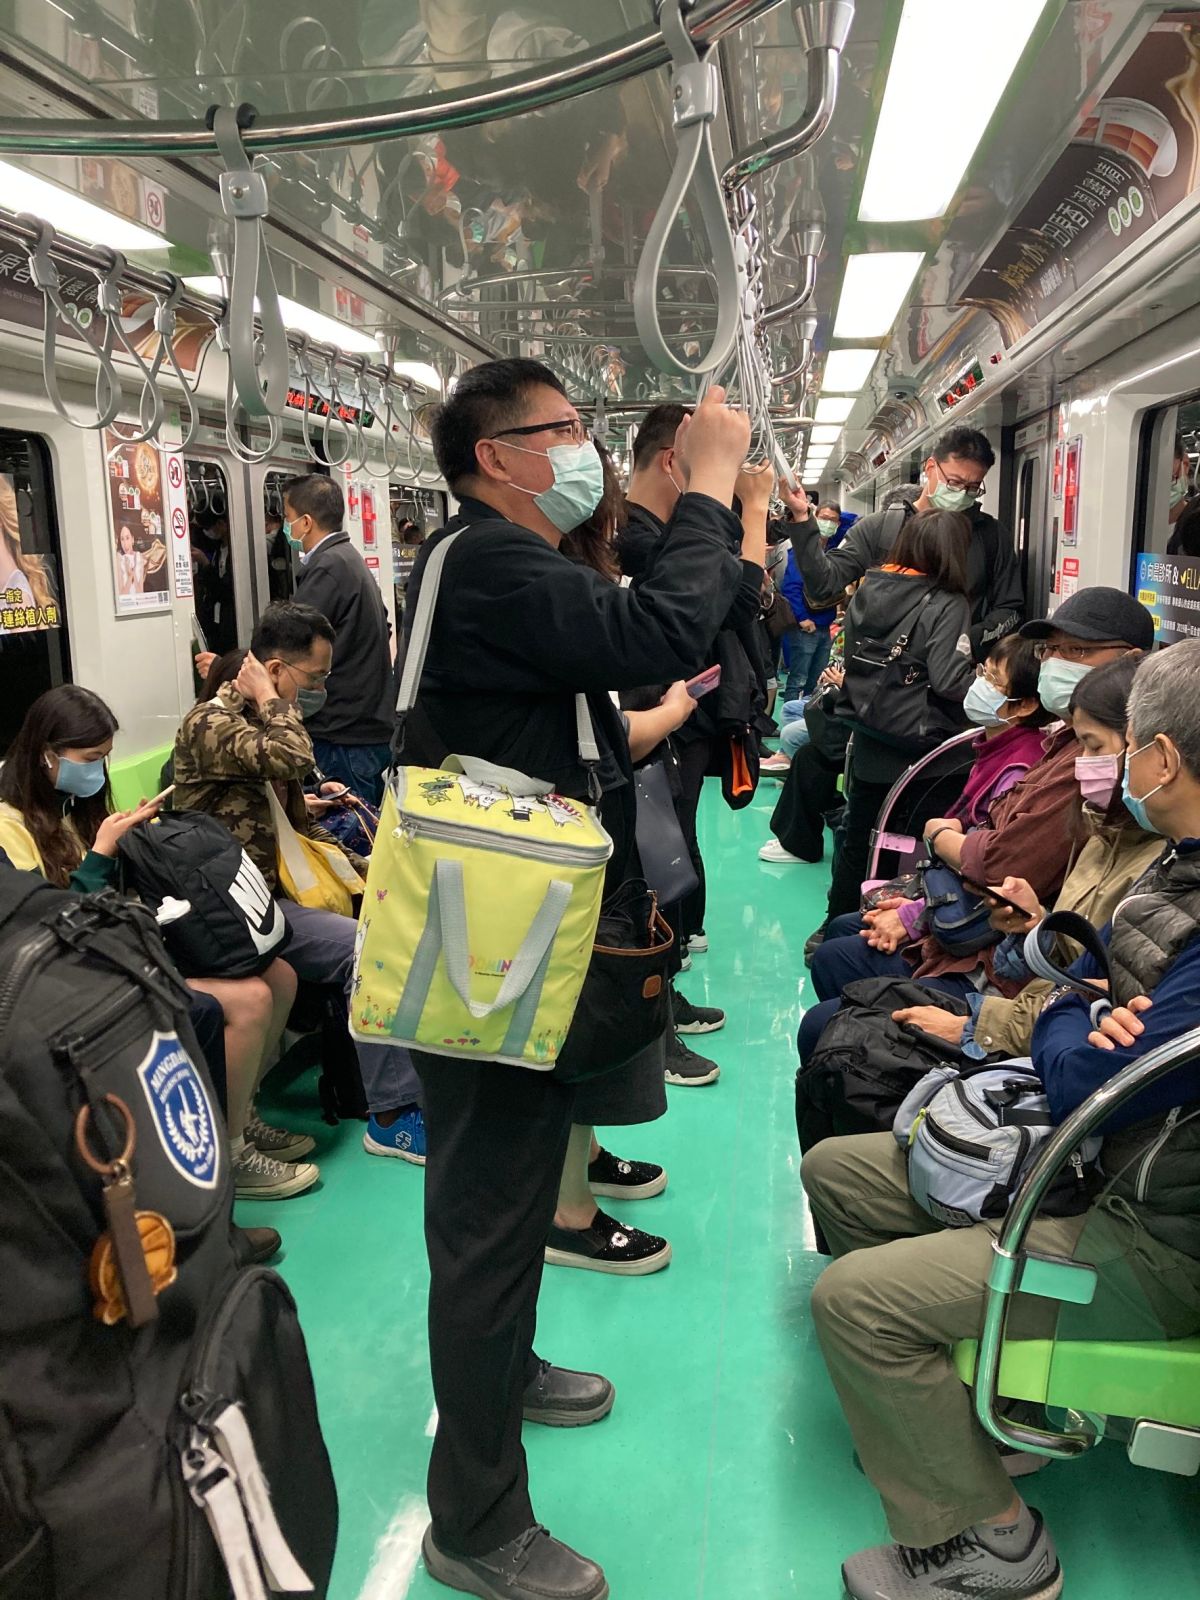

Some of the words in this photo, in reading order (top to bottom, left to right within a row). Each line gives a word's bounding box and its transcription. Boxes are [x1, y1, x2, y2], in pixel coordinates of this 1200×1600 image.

[1040, 202, 1089, 247] 田原香
[0, 250, 31, 284] 原香
[1172, 566, 1179, 586] &
[0, 606, 57, 629] 蓮絲植入劑
